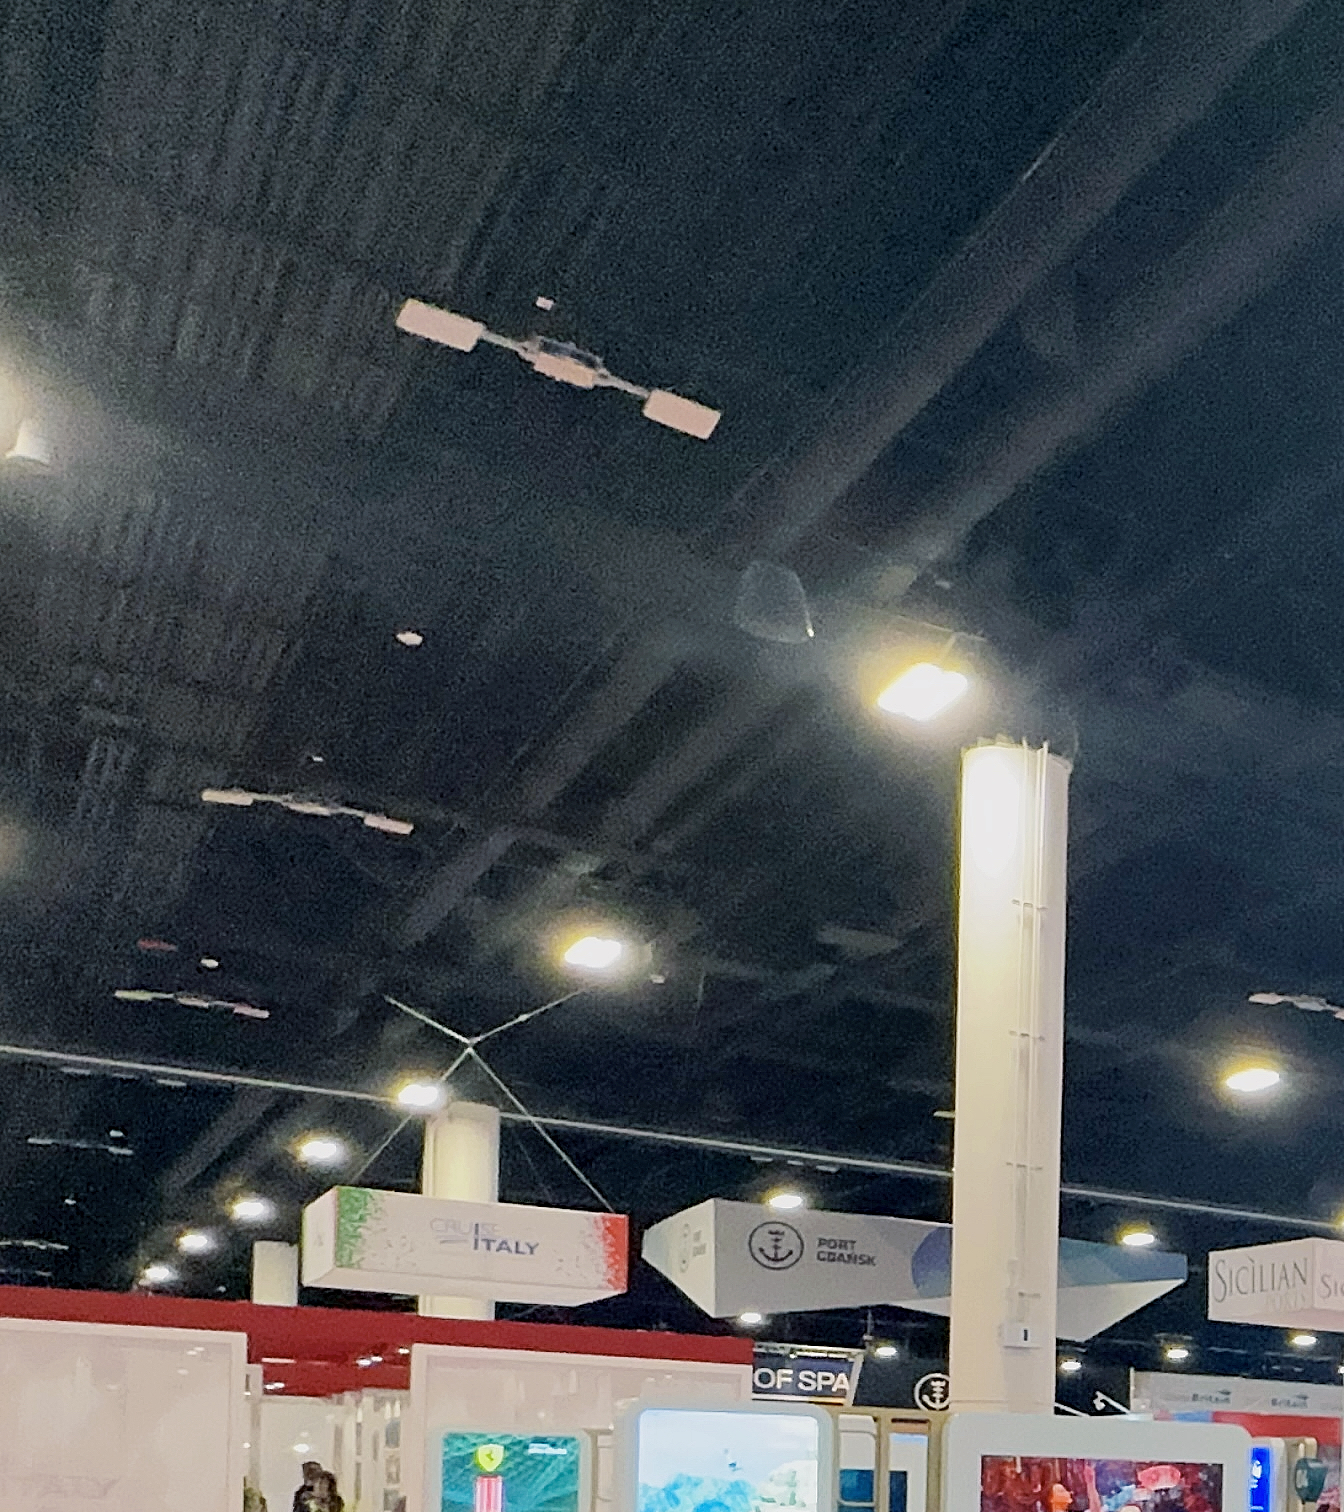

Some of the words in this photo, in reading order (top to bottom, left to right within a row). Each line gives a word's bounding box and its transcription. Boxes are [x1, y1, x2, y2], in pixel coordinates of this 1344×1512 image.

[473, 1227, 539, 1255] ITALY
[816, 1237, 857, 1250] PORT
[753, 1367, 793, 1389] OF
